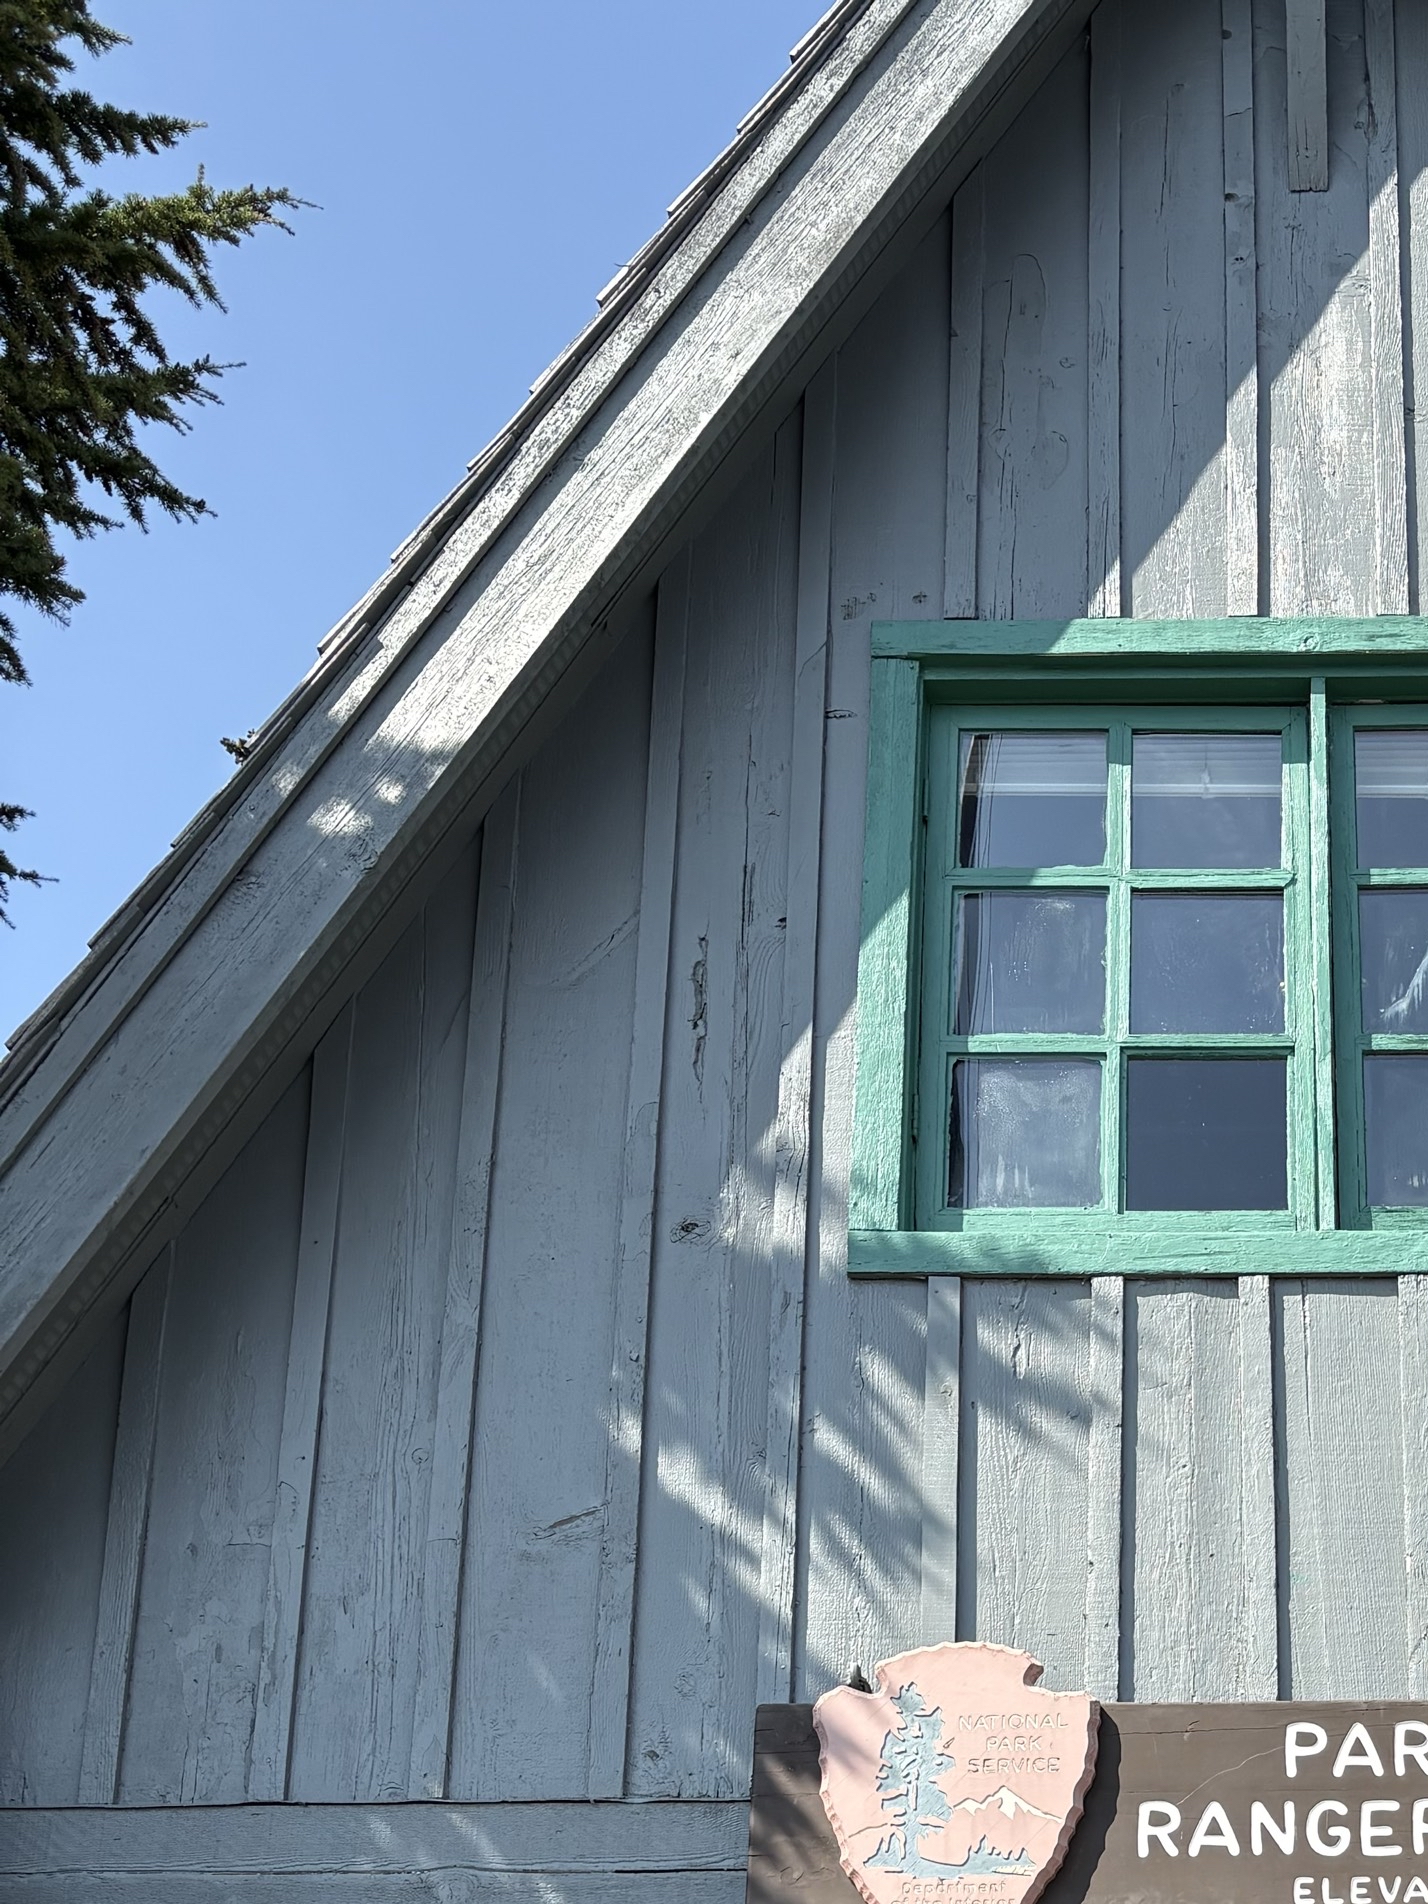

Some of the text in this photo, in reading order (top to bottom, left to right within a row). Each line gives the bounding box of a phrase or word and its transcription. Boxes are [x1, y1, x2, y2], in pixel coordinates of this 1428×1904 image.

[959, 1713, 1069, 1731] NATIONAL
[986, 1735, 1043, 1752] PARK
[967, 1757, 1060, 1774] SERVICE
[902, 1881, 1007, 1897] Department
